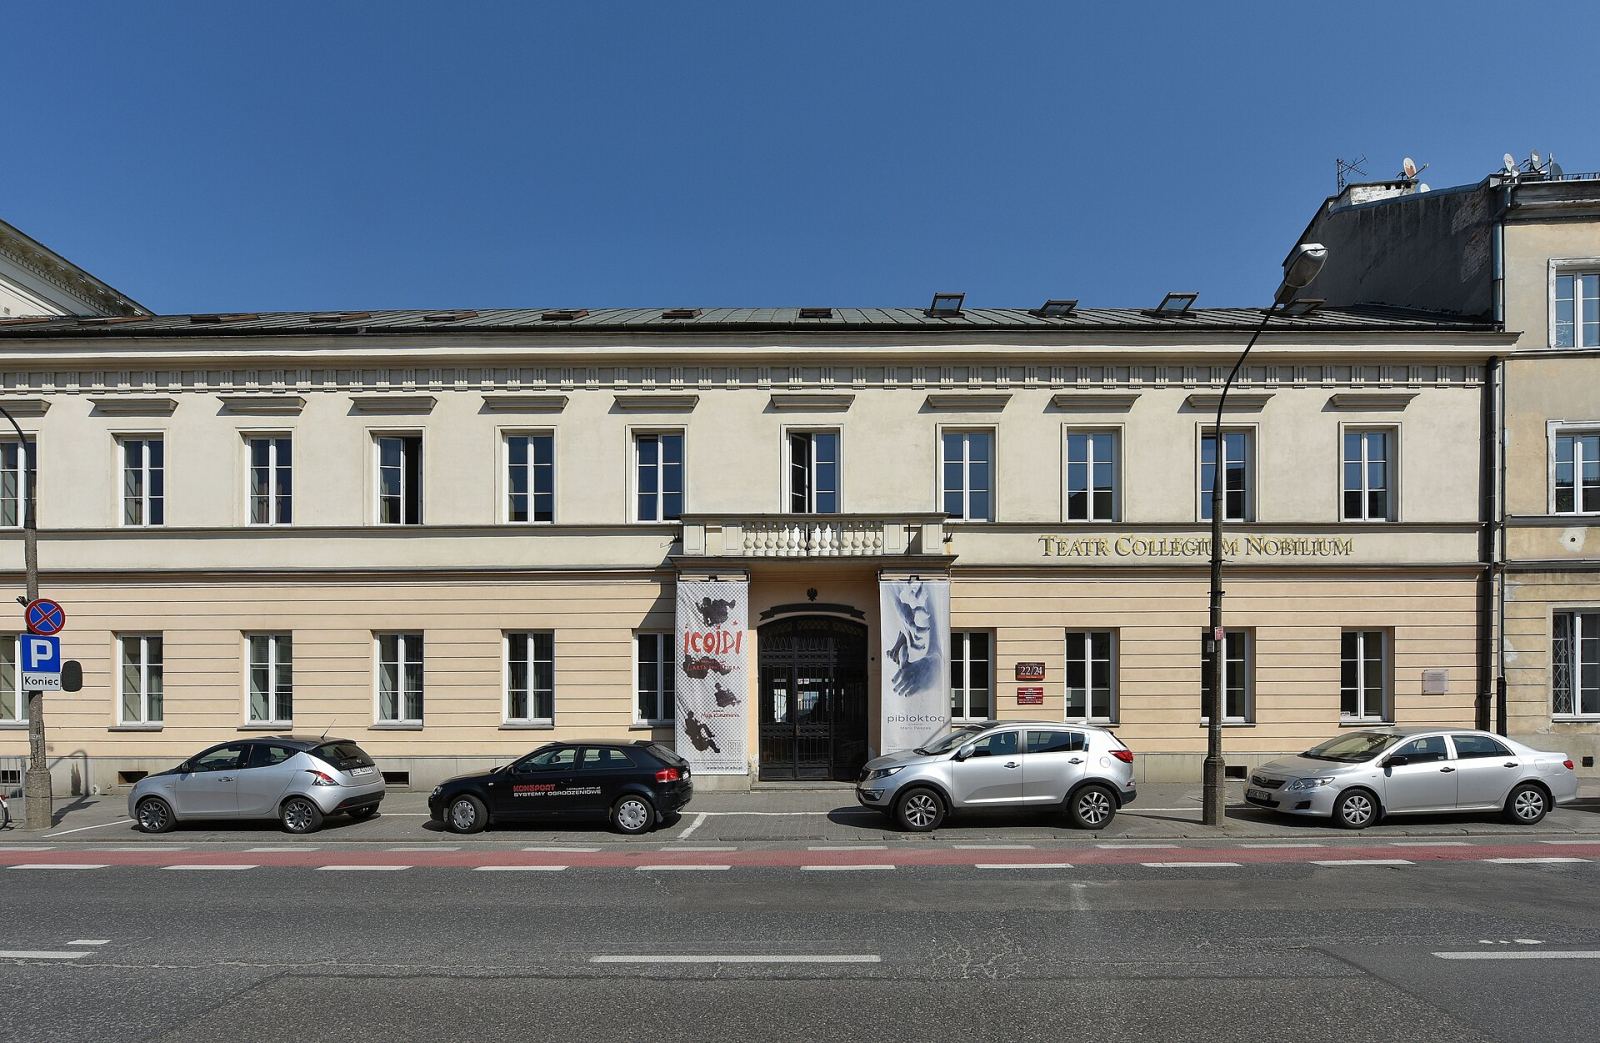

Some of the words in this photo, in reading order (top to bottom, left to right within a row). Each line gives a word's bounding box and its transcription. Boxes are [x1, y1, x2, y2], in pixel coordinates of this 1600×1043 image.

[1038, 534, 1111, 557] TEATR
[1244, 534, 1354, 557] NOBILIUM
[30, 639, 53, 668] P
[1020, 666, 1043, 676] 22/24
[24, 676, 59, 686] Koniec
[513, 784, 555, 792] KONSPORT
